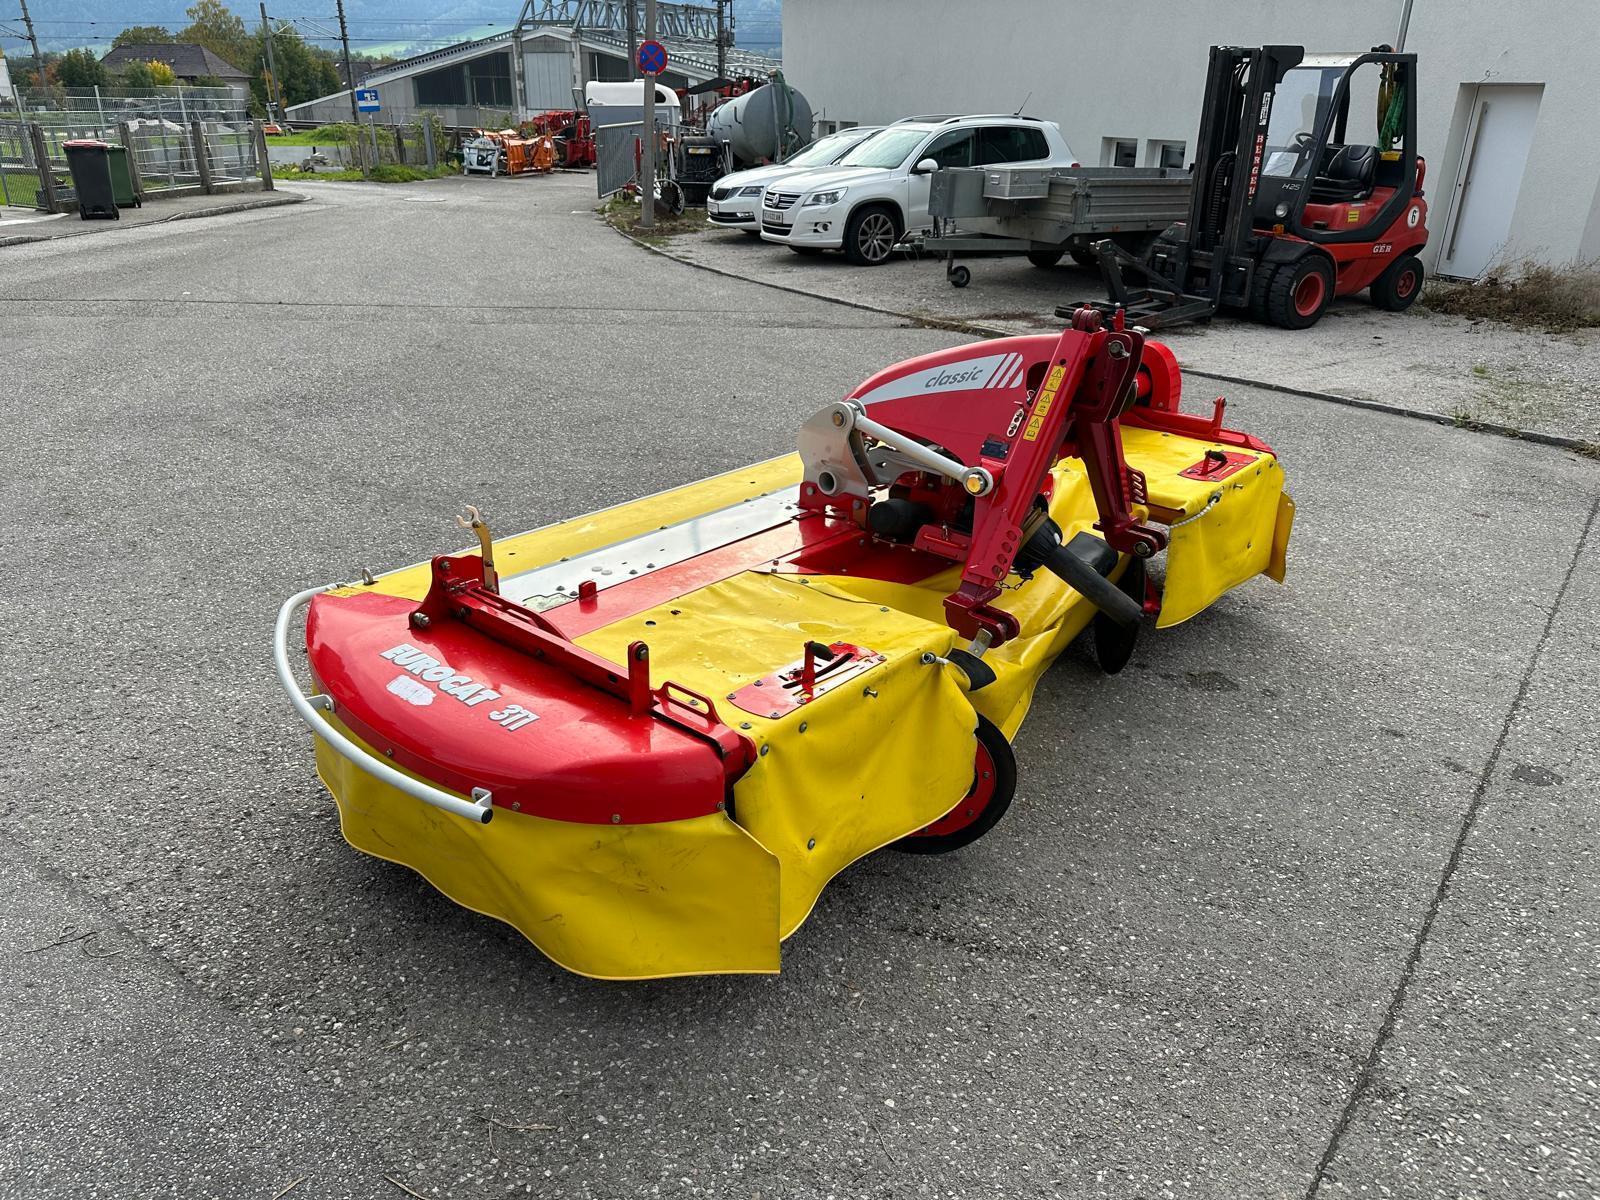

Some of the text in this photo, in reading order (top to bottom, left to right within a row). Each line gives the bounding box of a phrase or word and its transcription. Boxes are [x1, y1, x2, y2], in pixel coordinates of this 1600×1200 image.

[1248, 135, 1264, 194] BERGER
[1281, 183, 1302, 191] H25
[1411, 209, 1418, 225] 6
[924, 366, 983, 388] classic
[379, 643, 502, 707] EUROCAT
